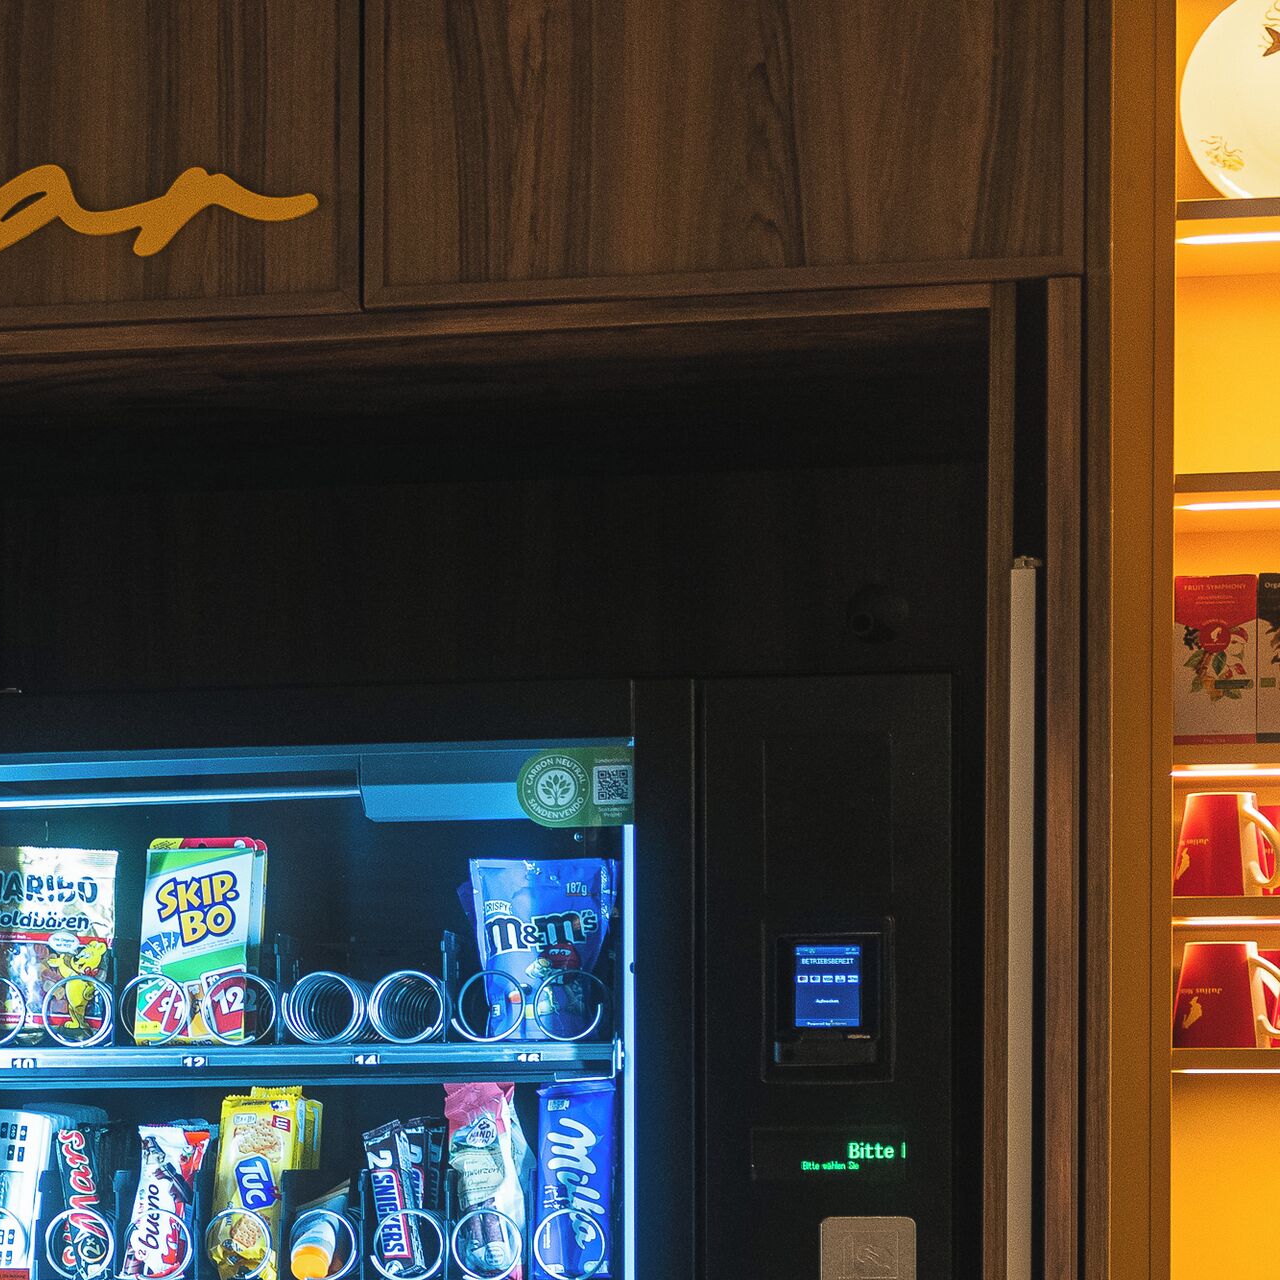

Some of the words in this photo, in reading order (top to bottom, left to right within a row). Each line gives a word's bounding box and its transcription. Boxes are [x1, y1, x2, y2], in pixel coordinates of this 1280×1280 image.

[526, 758, 554, 786] CARBON
[555, 757, 586, 784] NEUTRAL
[528, 796, 584, 819] SANDENVENDO
[566, 882, 588, 897] 187g
[179, 904, 236, 947] BO
[183, 1057, 206, 1067] 12
[355, 1054, 378, 1064] 14
[847, 1142, 894, 1159] Bitte
[801, 1161, 820, 1170] Bitte
[848, 1161, 859, 1170] Sie
[546, 1117, 606, 1250] Milka
[138, 1183, 160, 1250] bueno
[372, 1174, 405, 1253] SNICKERS
